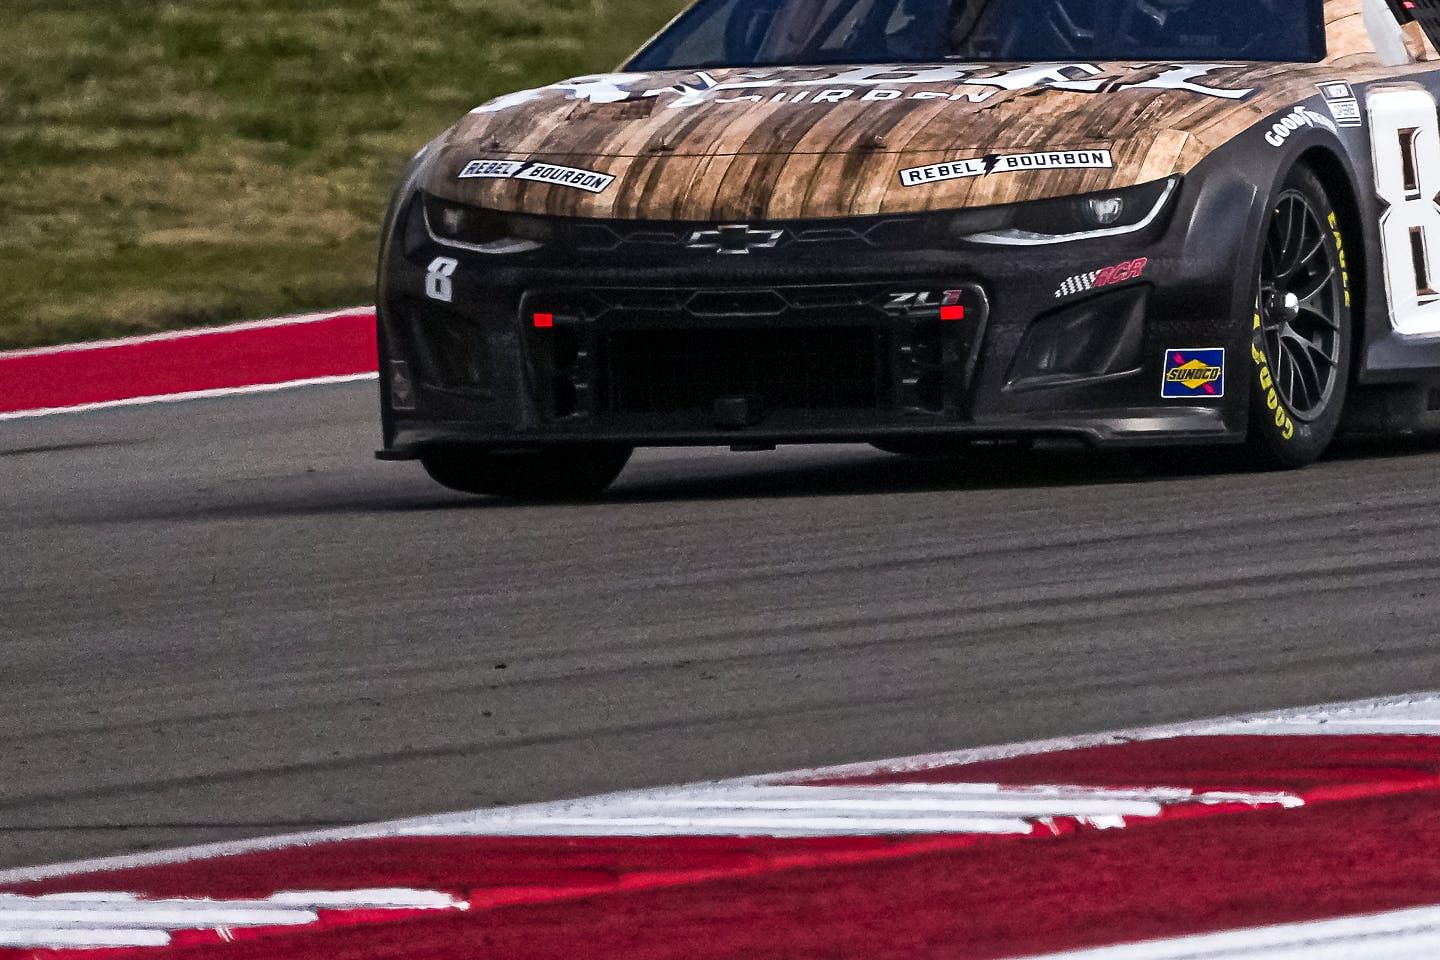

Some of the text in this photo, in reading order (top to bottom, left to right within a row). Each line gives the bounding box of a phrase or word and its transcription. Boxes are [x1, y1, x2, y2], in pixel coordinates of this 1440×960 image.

[463, 161, 607, 189] REBEL BOURBON
[908, 151, 1105, 183] REBEL BOURBON
[425, 255, 459, 303] 8
[1168, 367, 1220, 381] SUNOCO
